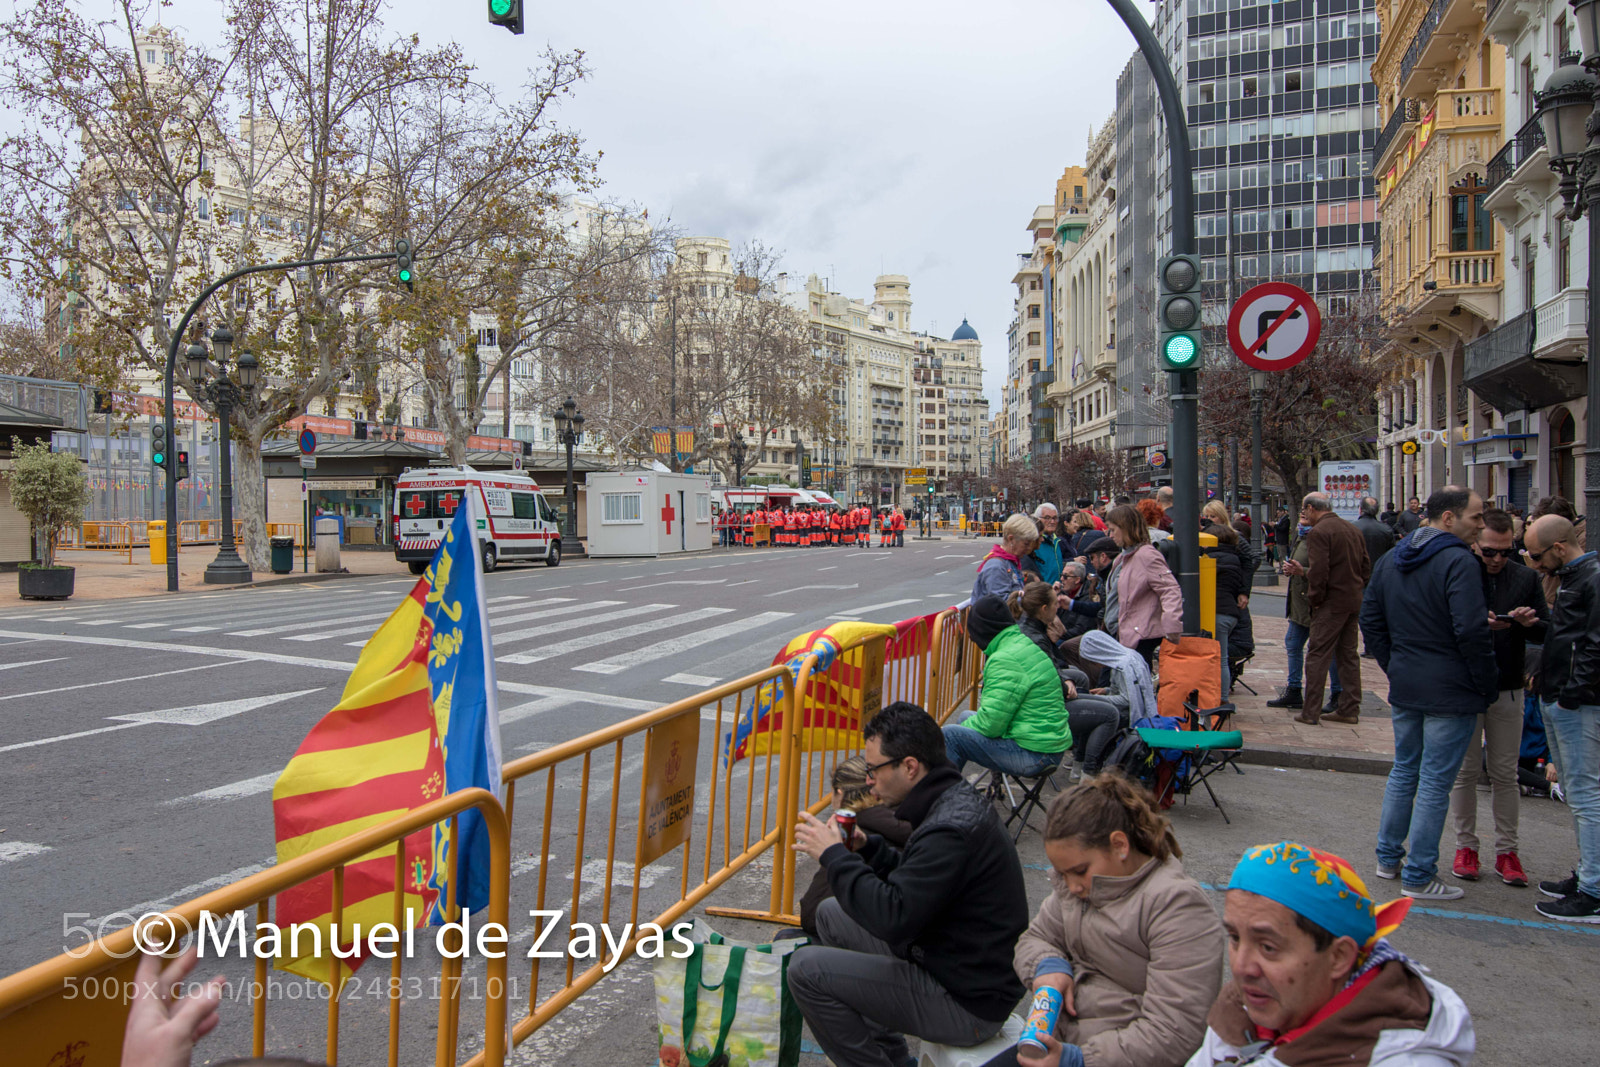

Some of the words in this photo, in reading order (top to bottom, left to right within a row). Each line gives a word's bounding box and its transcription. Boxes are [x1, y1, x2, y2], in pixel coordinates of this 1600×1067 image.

[409, 480, 456, 488] AMBULANCIA
[649, 785, 691, 819] AJUNTAMENT
[647, 822, 657, 840] DE
